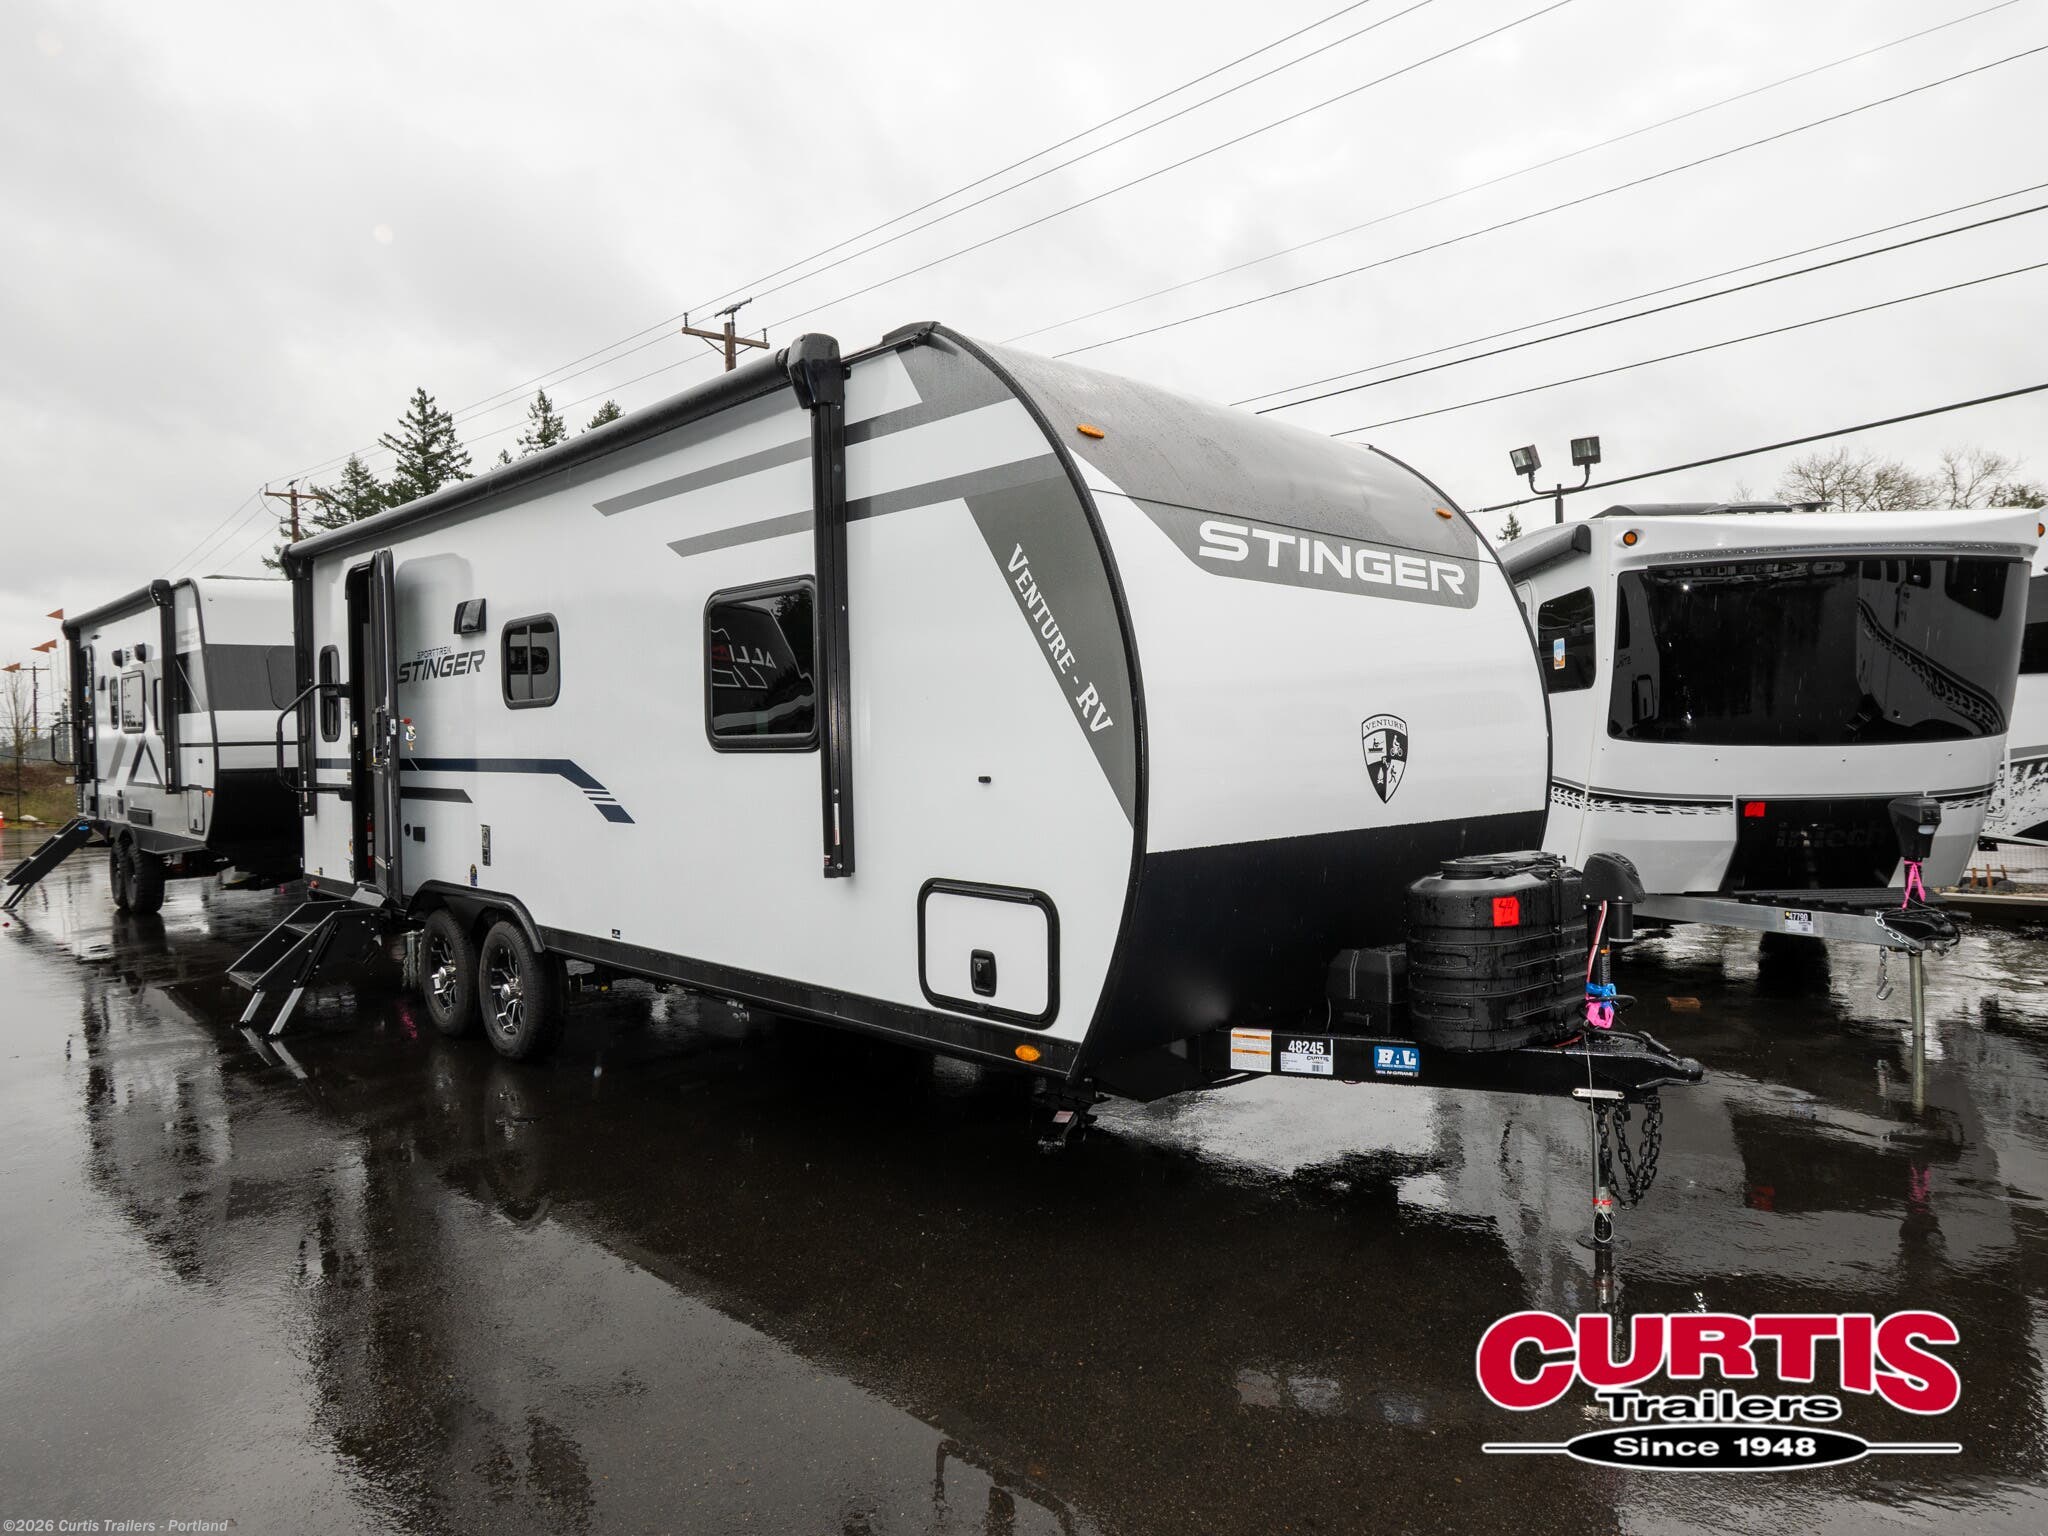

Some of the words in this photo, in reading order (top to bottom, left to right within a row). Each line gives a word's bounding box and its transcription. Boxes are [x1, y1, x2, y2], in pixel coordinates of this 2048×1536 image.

[1198, 519, 1466, 595] STINGER
[1007, 543, 1076, 675] VENTURE
[1075, 682, 1114, 732] RV
[397, 649, 486, 685] STINGER
[1365, 719, 1404, 731] VENTURE
[1288, 1040, 1325, 1055] 48245
